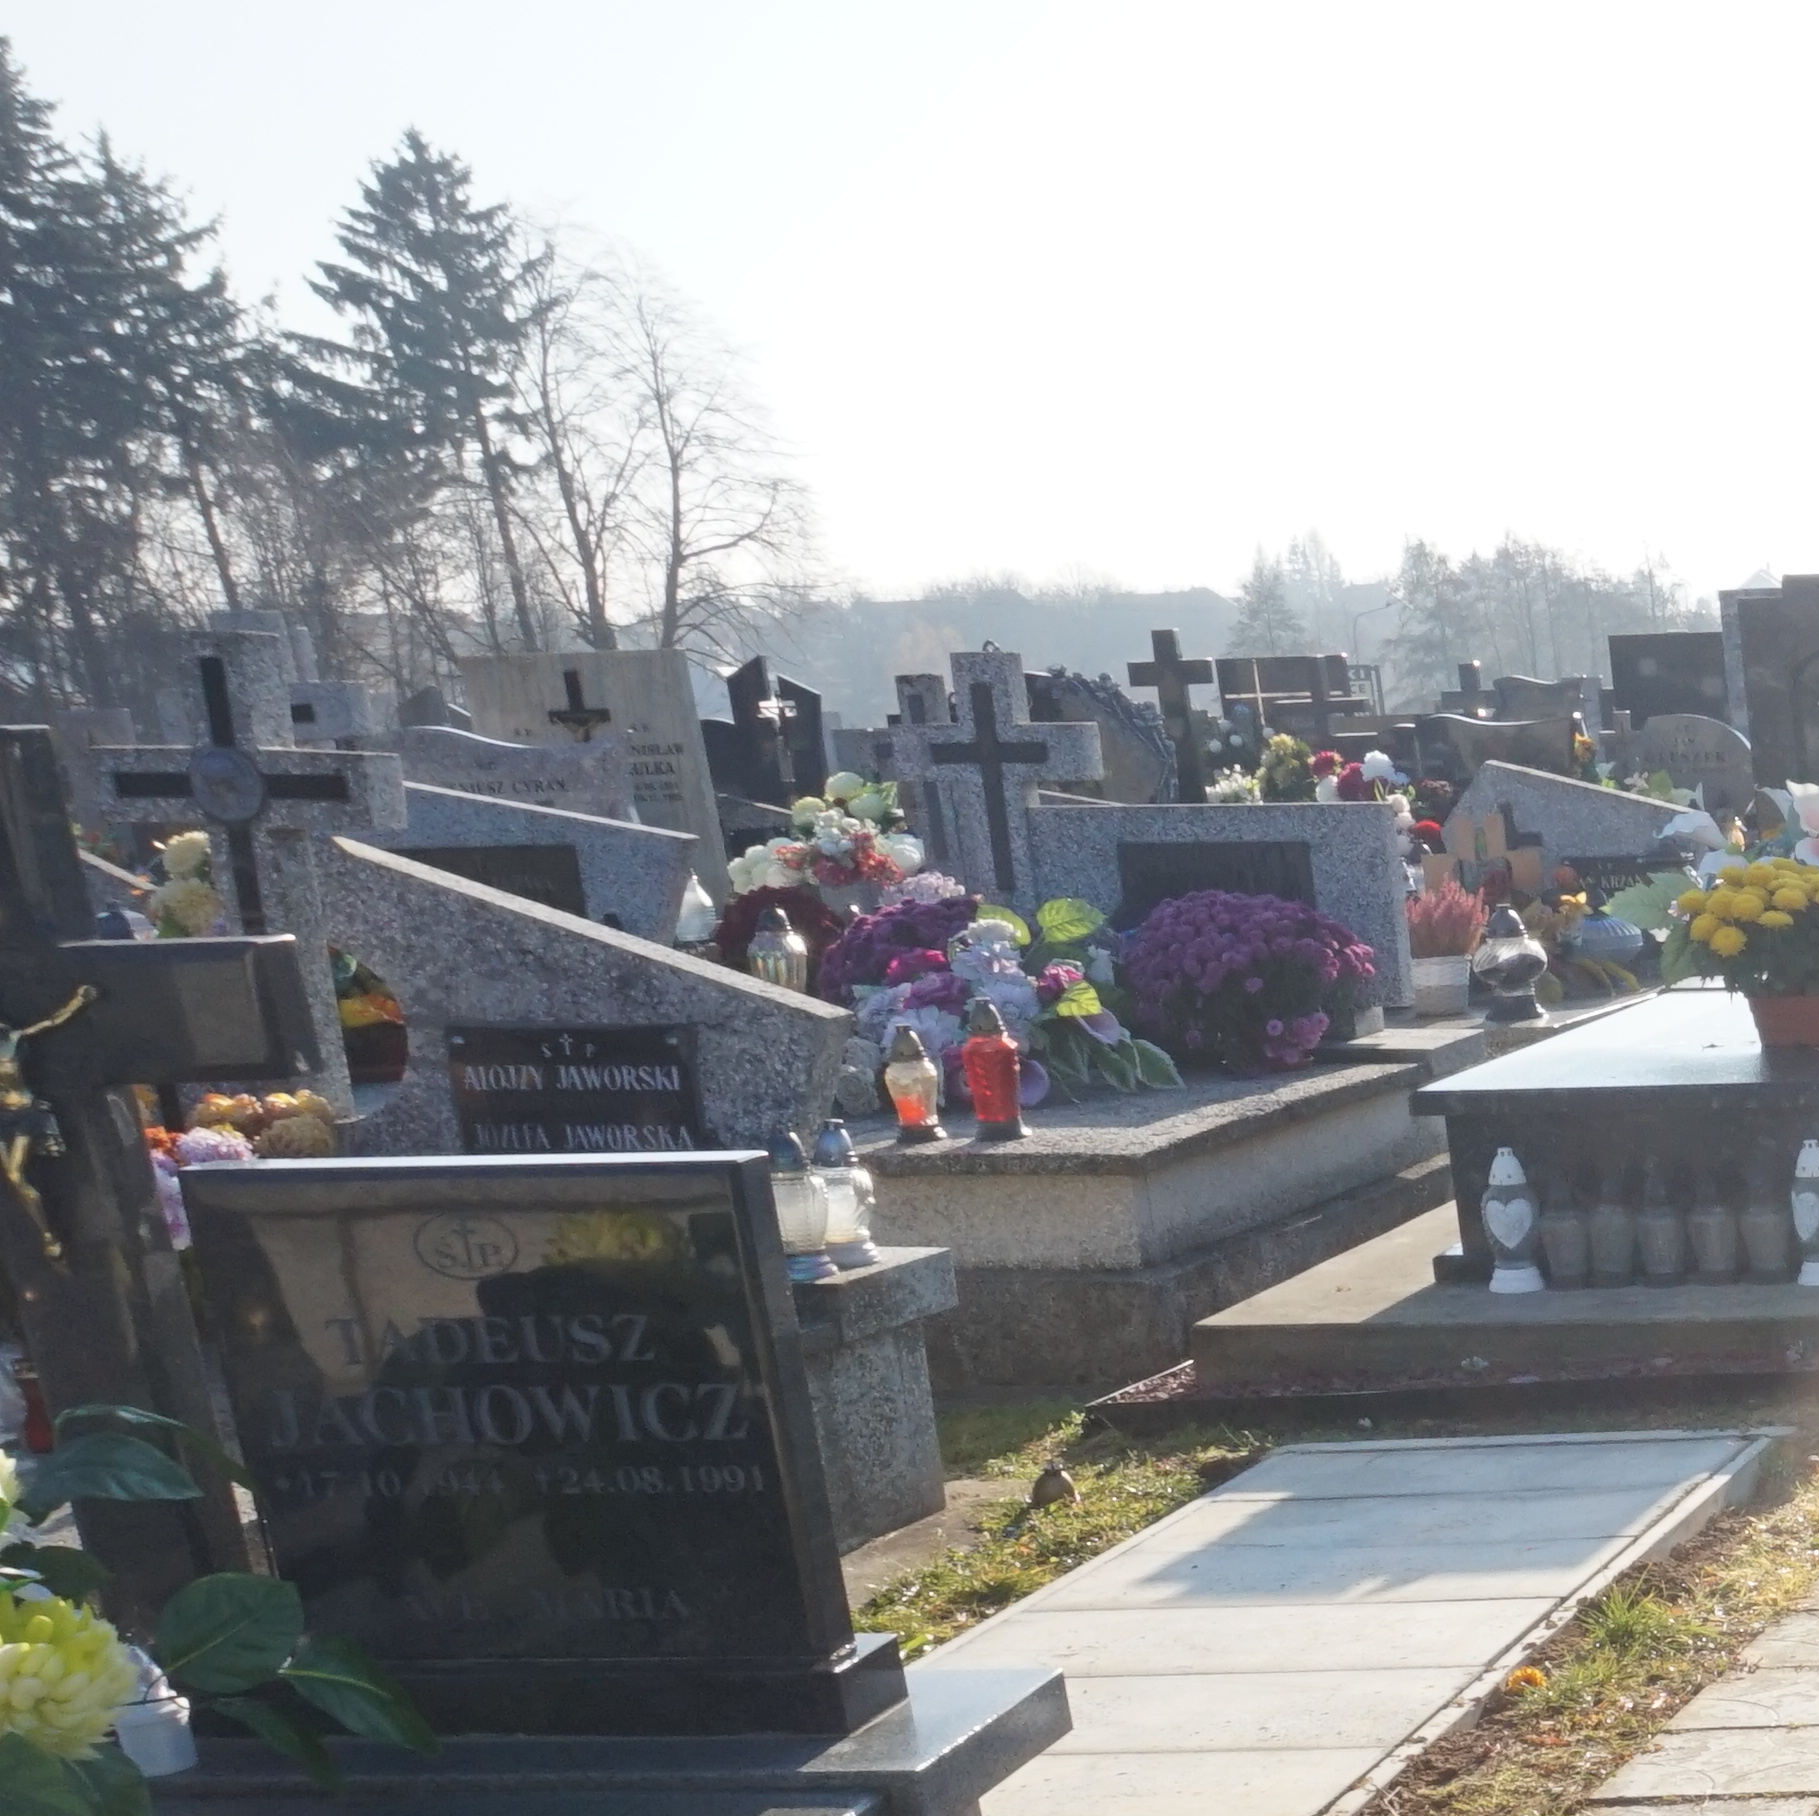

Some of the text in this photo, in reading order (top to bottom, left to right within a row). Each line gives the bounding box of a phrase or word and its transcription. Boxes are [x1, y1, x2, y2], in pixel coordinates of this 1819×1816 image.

[555, 1064, 680, 1092] JAWORSKI
[563, 1123, 696, 1151] JAWORSKA
[324, 1313, 656, 1366] TADEUSZ
[270, 1382, 749, 1449] JACHOWICZ
